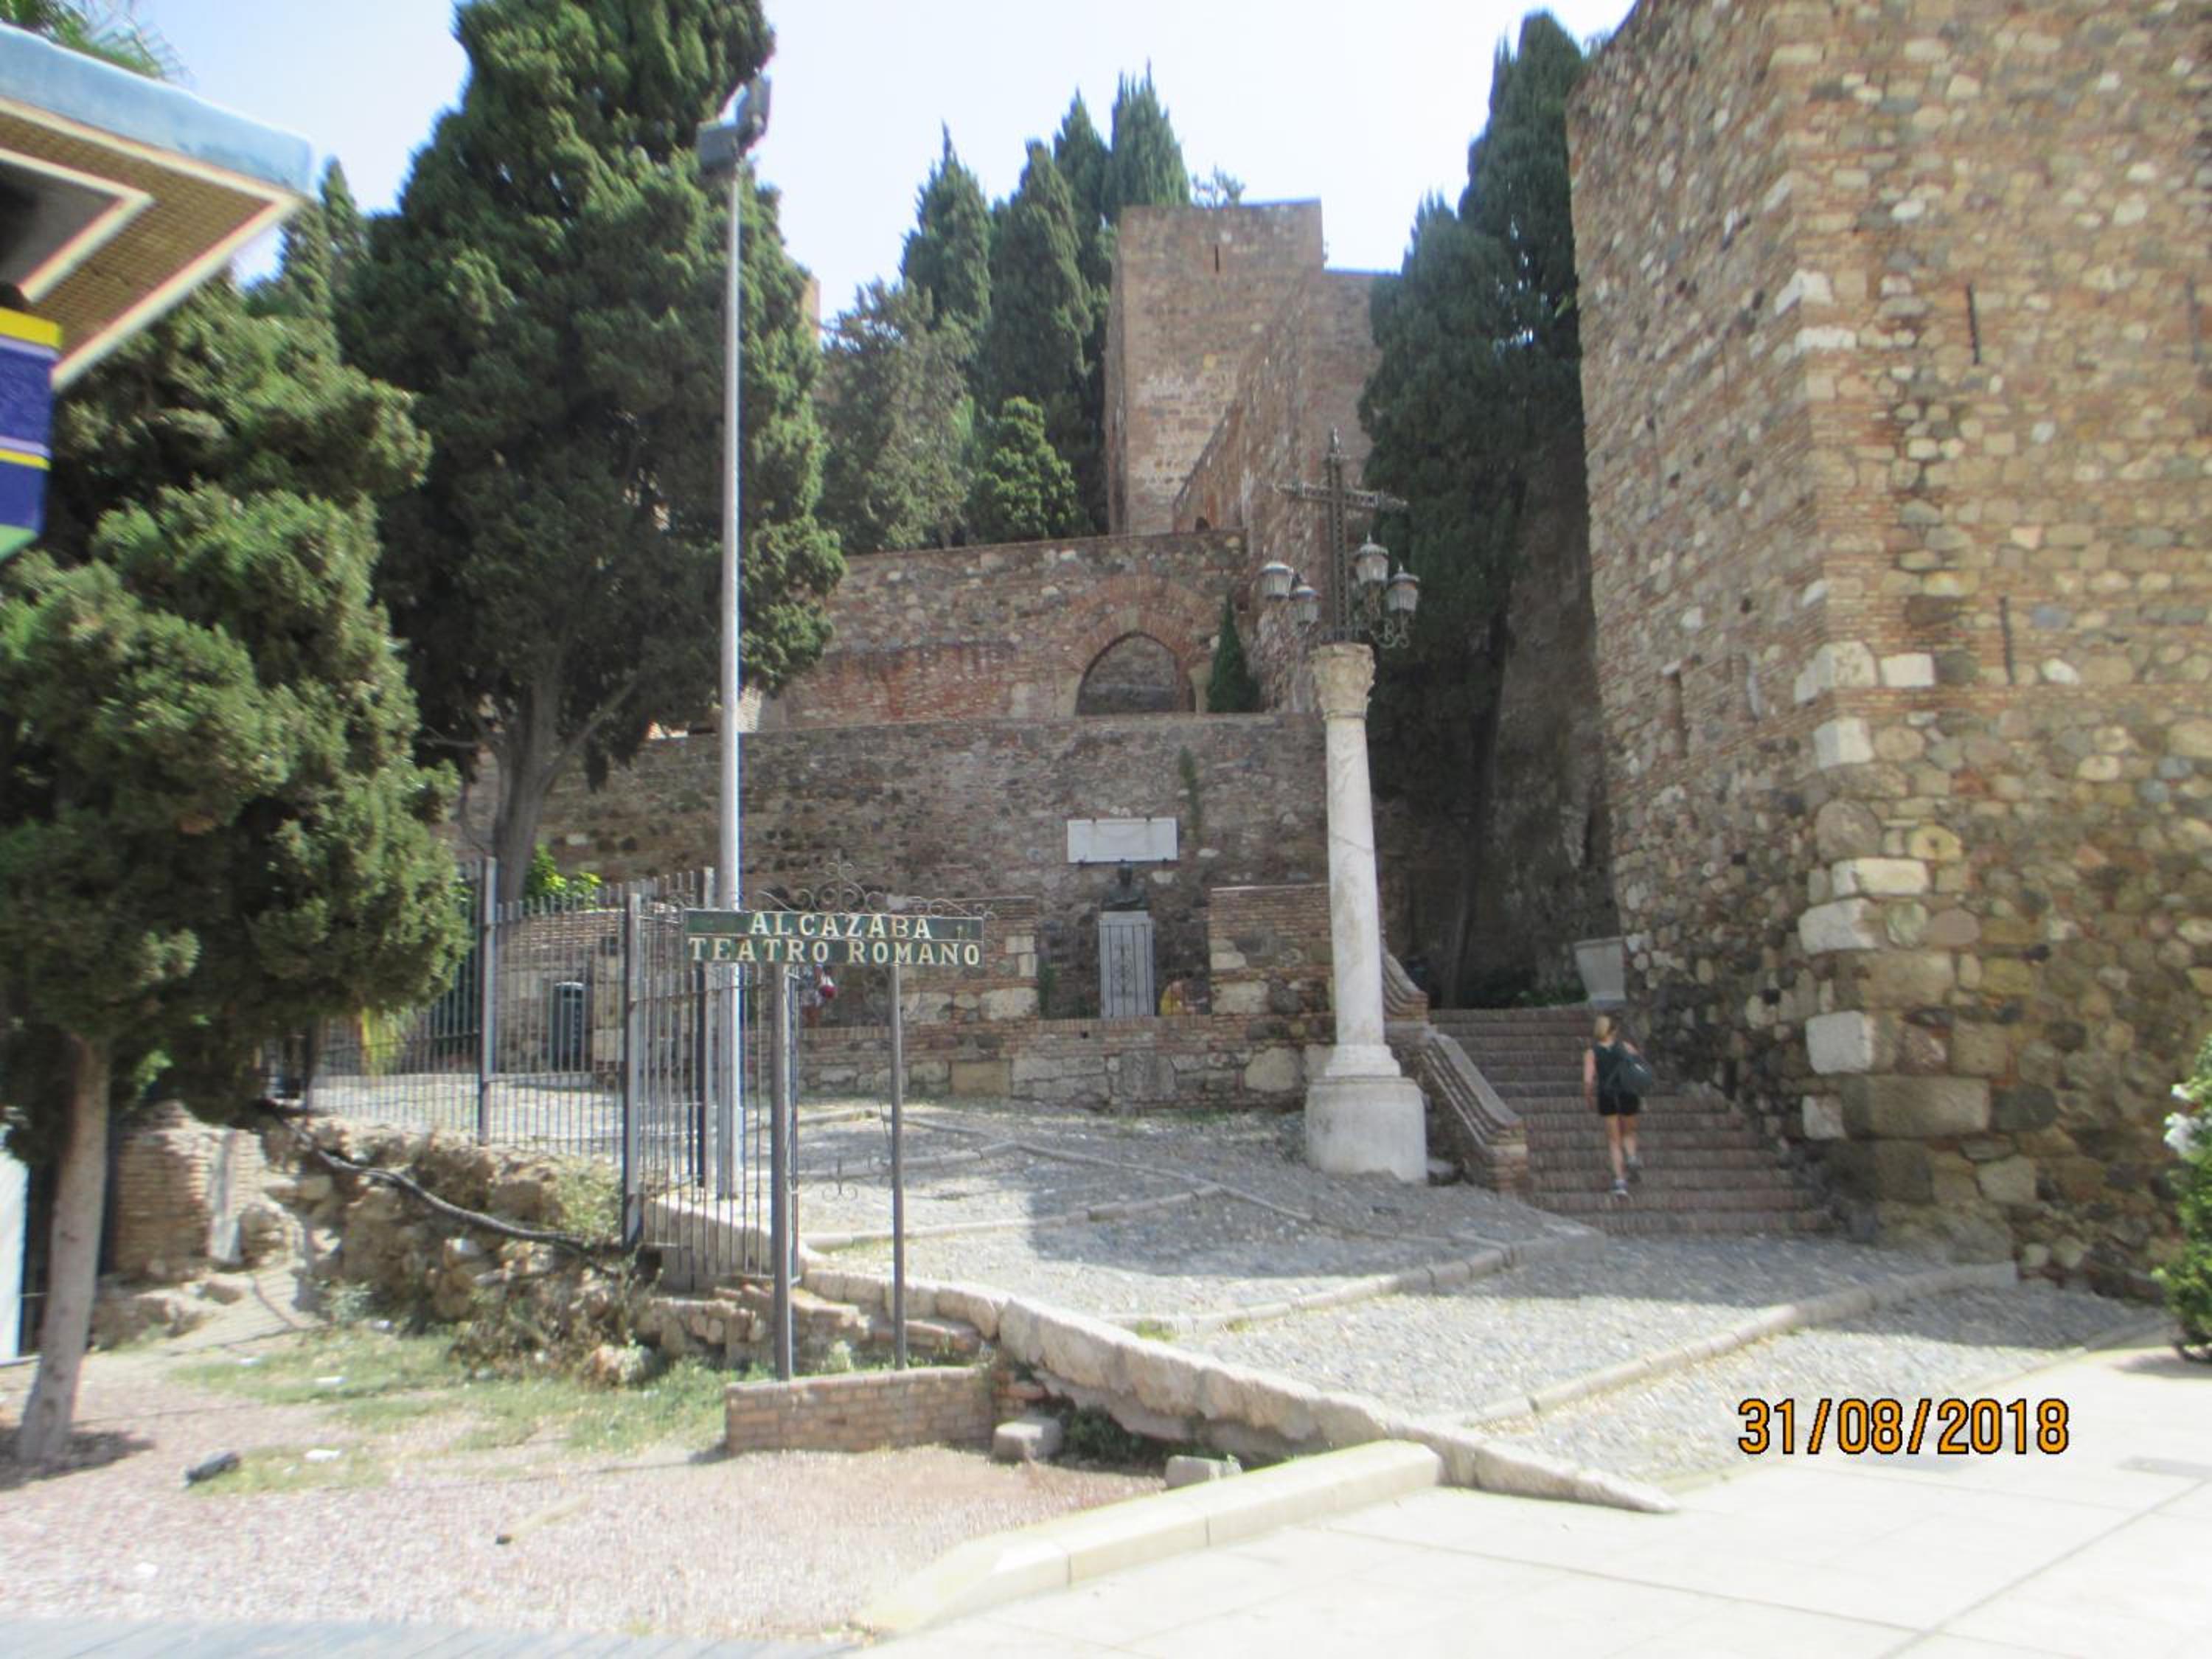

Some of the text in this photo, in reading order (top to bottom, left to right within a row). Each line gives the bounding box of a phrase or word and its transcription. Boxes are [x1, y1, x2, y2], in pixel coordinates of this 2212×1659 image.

[750, 913, 932, 939] ALCAZABA
[688, 937, 980, 966] TEATRO ROMANO
